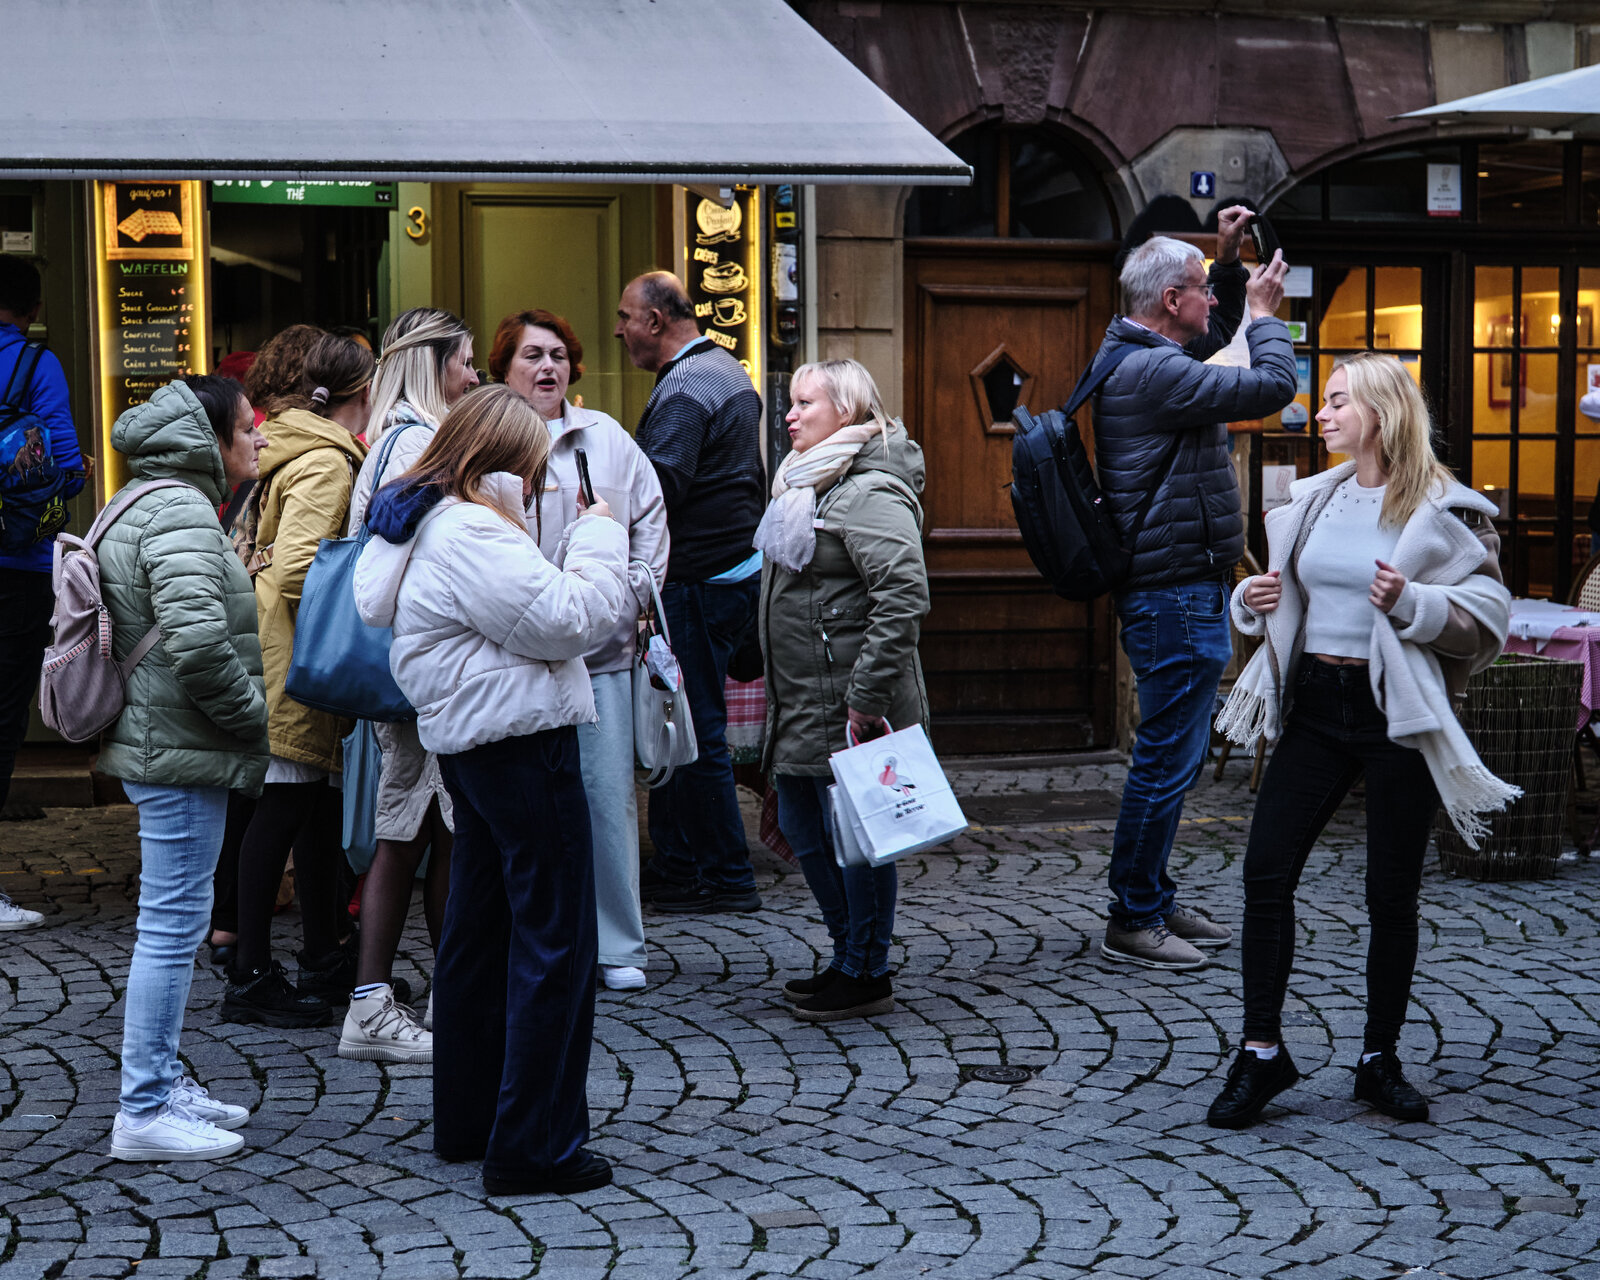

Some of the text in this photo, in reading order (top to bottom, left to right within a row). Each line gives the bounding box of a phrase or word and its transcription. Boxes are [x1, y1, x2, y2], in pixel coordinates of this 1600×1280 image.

[1197, 174, 1209, 194] 4
[286, 186, 305, 201] THÉ
[406, 206, 425, 238] 3
[120, 262, 188, 274] WAFFELN
